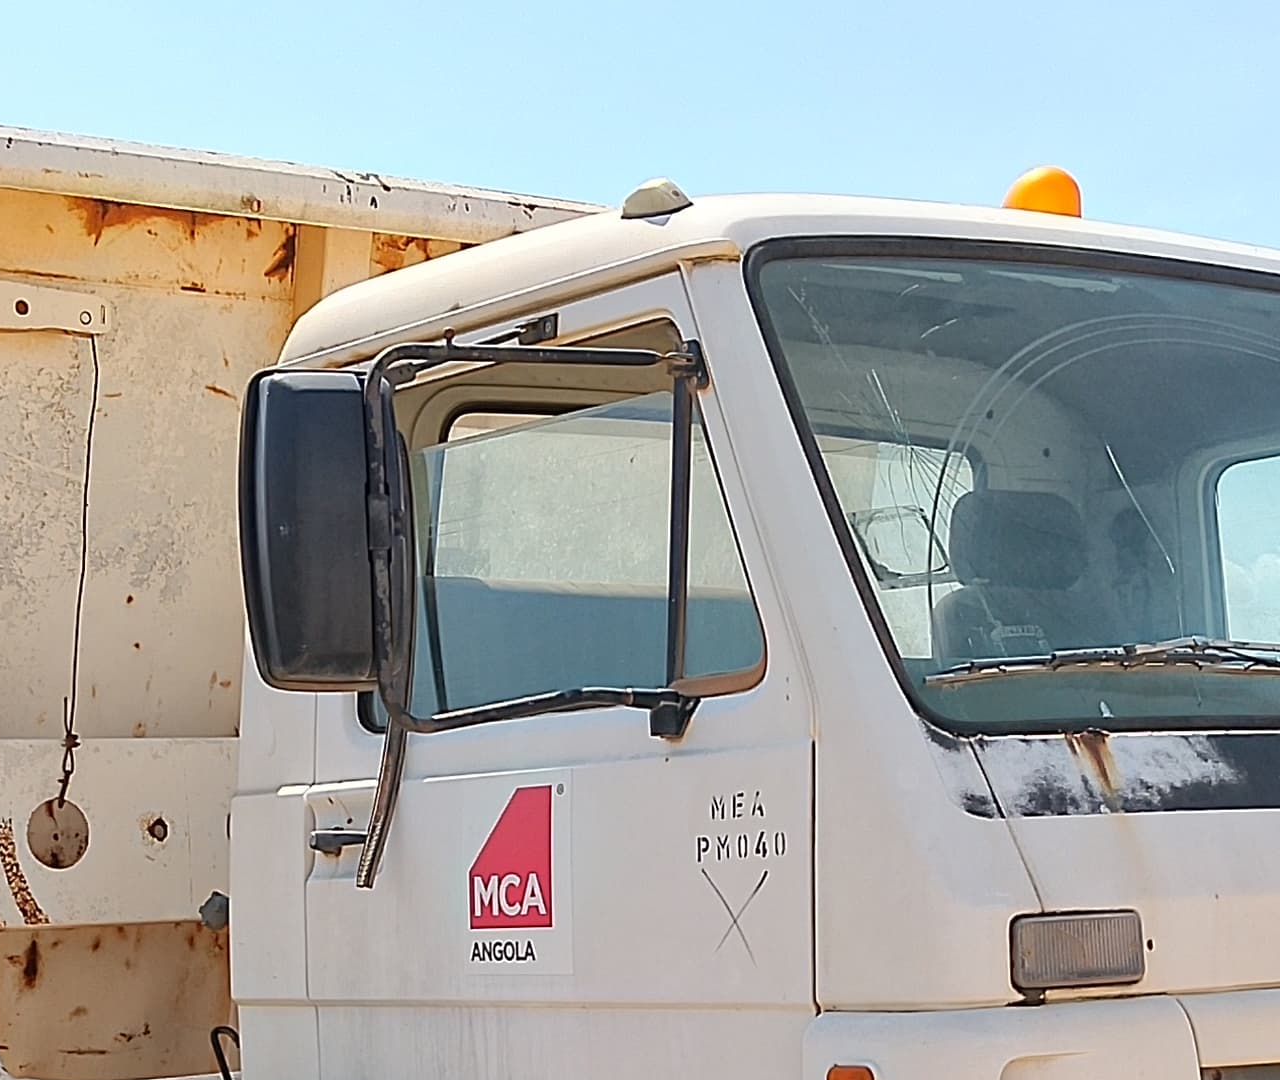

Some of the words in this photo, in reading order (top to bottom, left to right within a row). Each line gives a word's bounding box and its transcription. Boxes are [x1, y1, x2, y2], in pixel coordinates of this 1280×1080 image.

[711, 790, 764, 820] MEA
[697, 831, 786, 862] PM040
[473, 873, 547, 917] MCA
[471, 941, 536, 962] ANGOLA
